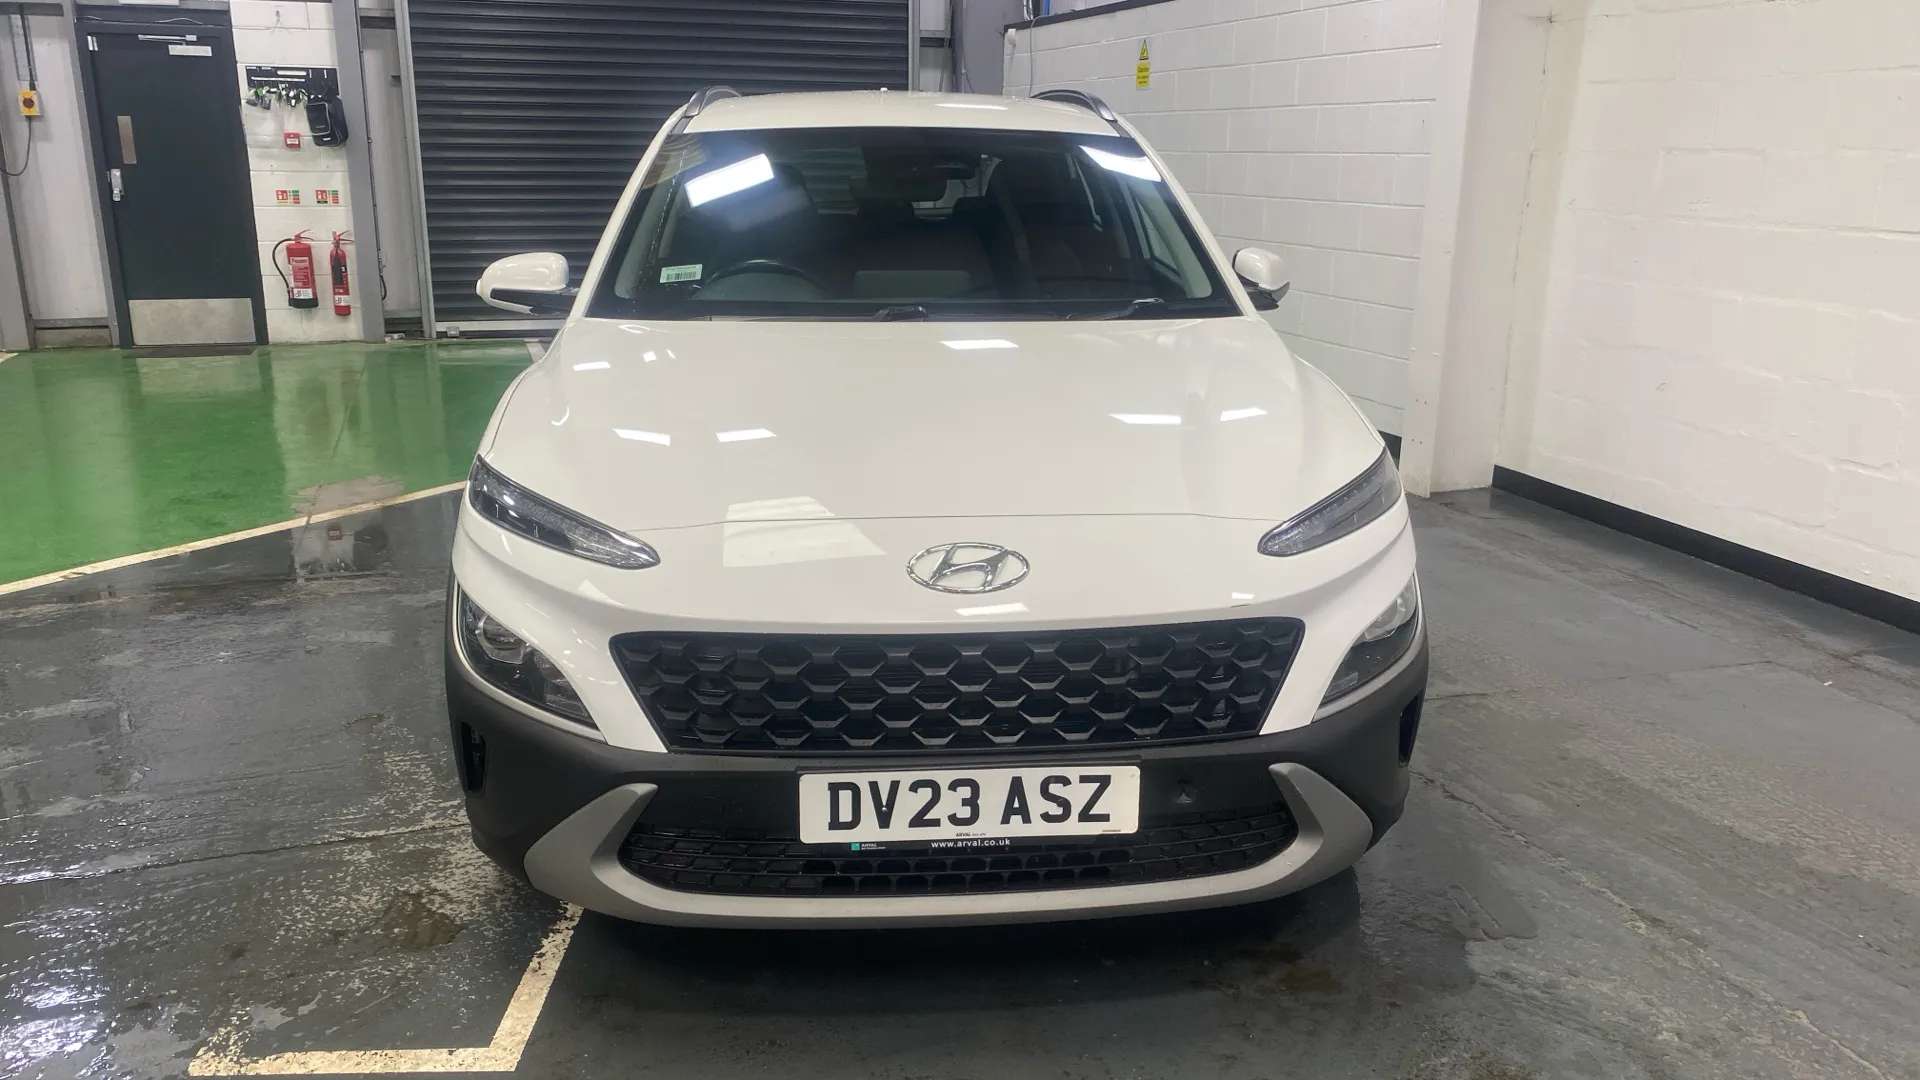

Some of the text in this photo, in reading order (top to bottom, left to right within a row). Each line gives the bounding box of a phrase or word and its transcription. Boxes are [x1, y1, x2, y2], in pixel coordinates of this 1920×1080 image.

[828, 774, 1112, 831] DV23 ASZ
[931, 839, 1011, 848] www.arval.co.uk
